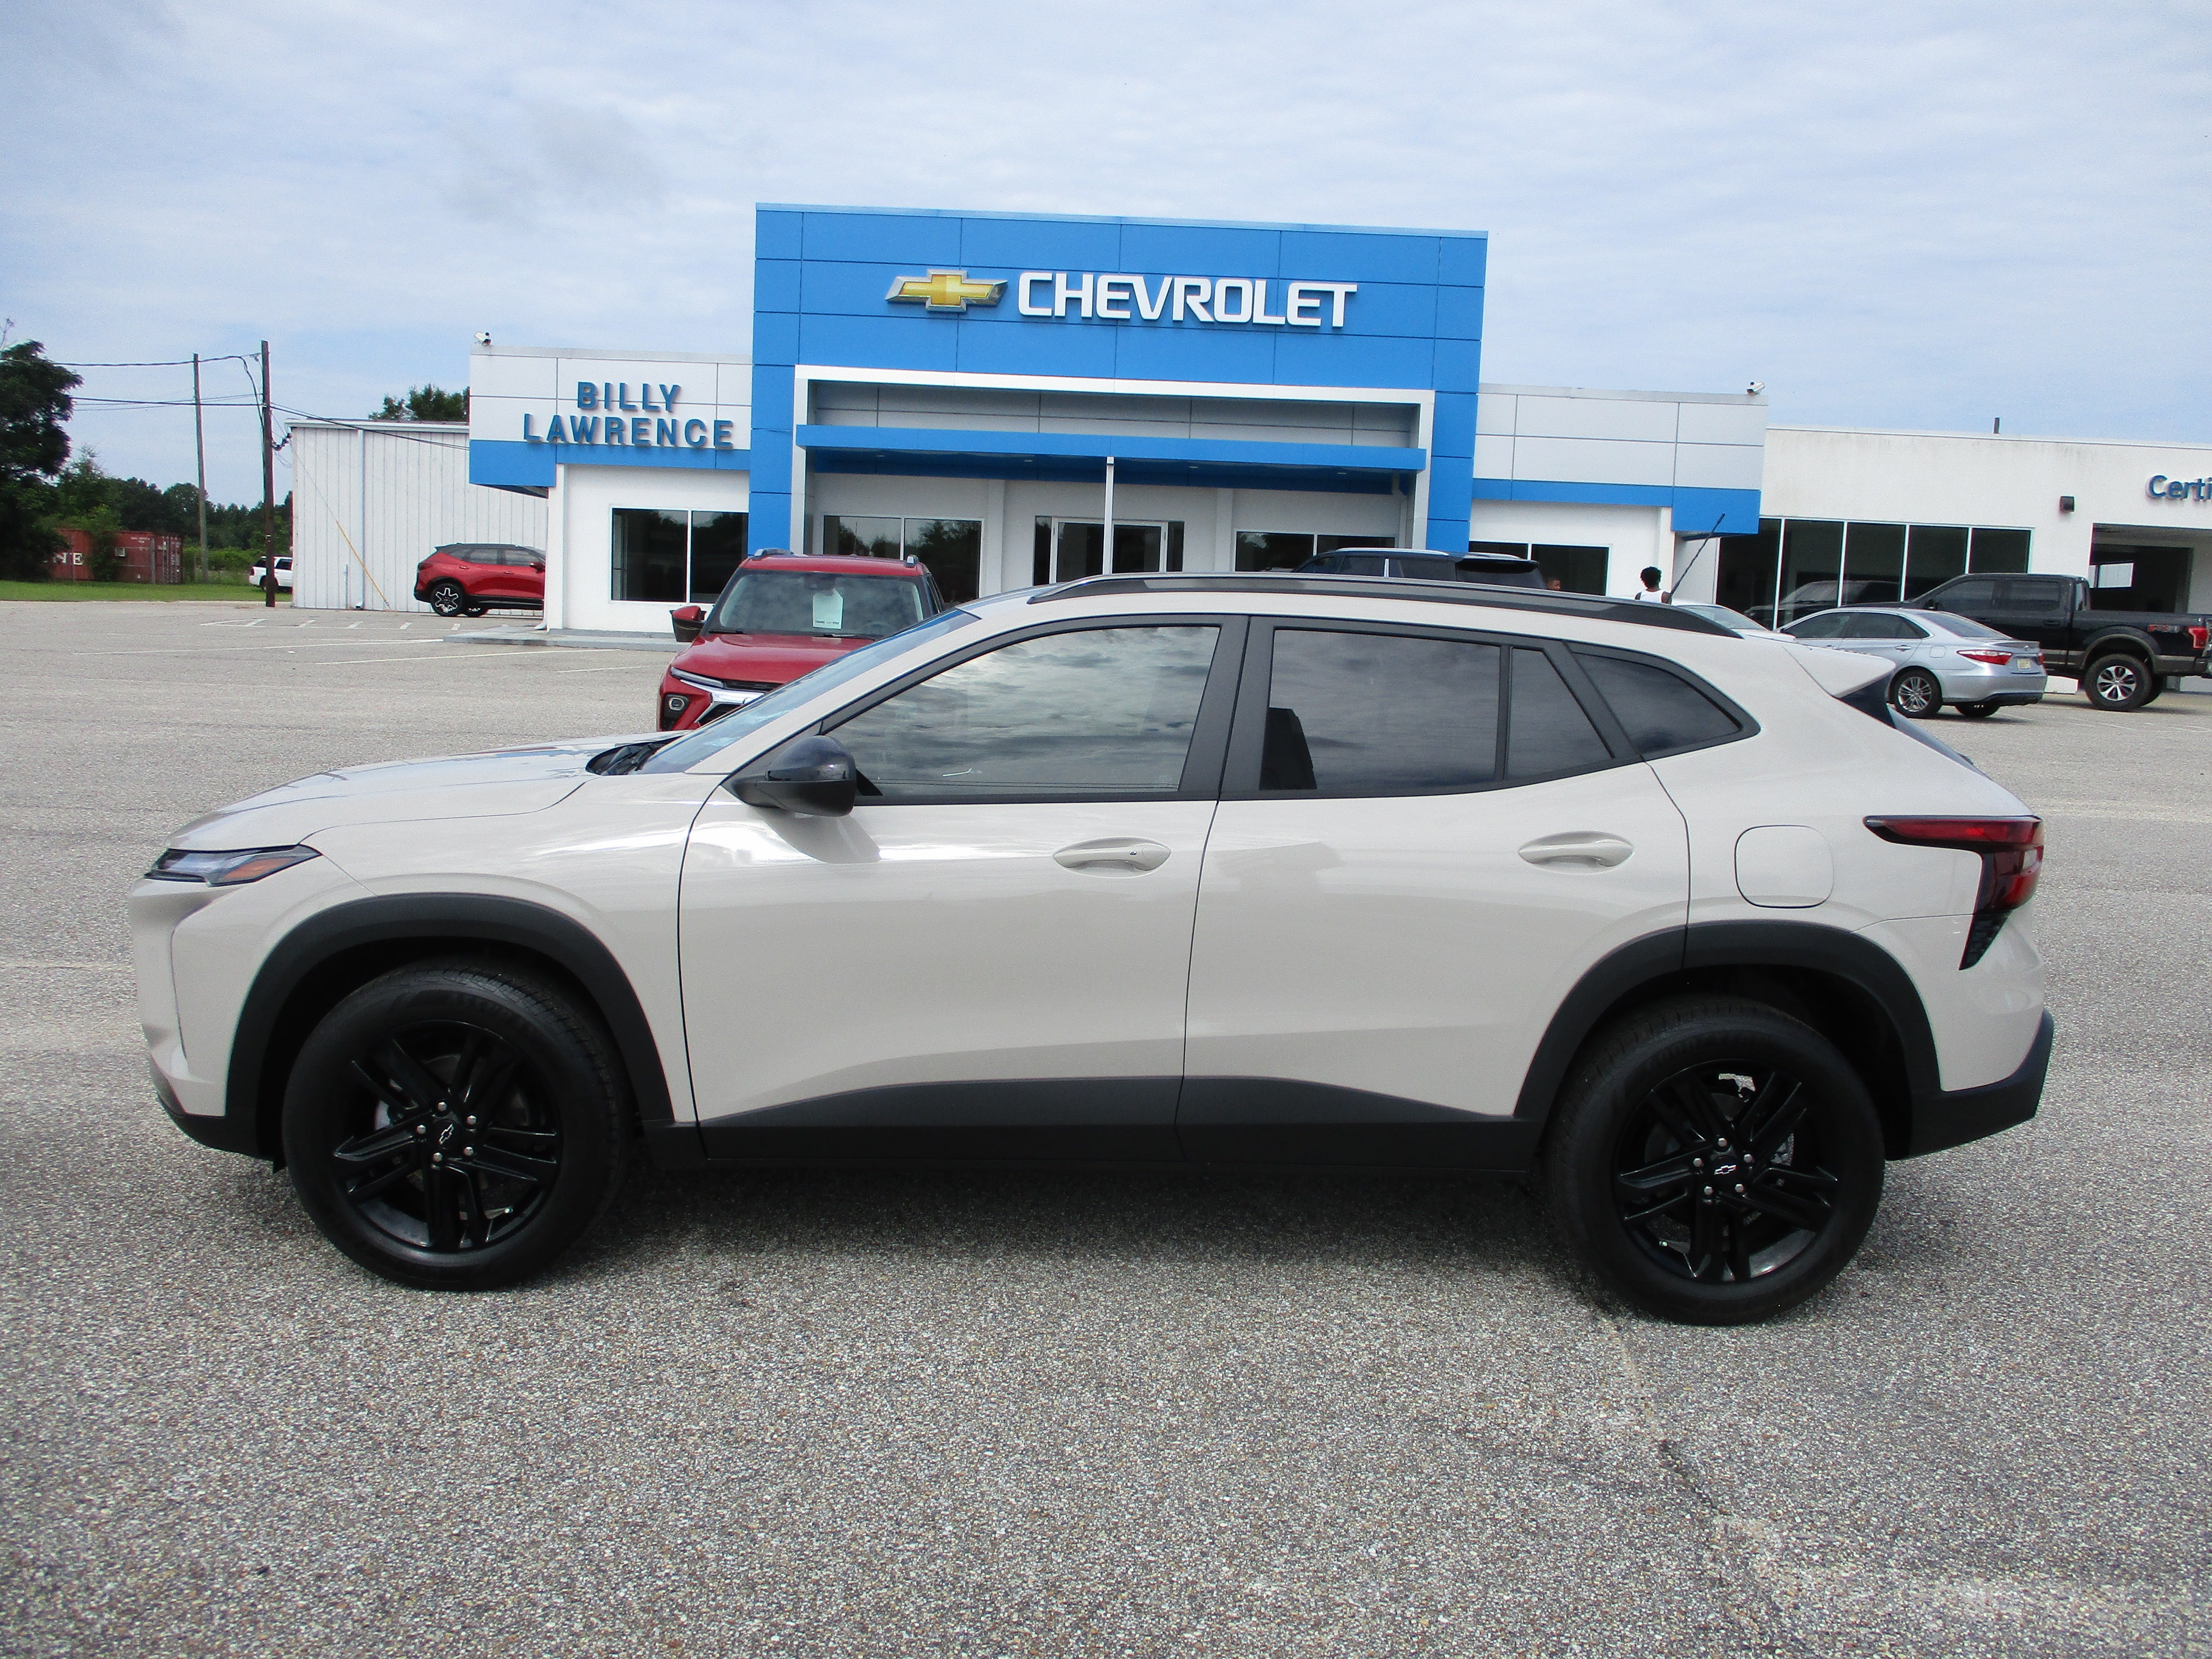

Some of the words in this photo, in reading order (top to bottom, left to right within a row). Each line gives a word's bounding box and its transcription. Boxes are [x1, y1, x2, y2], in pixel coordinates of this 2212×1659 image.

[1018, 272, 1357, 328] CHEVROLET
[577, 382, 681, 412] BILLY
[523, 413, 733, 448] LAWRENCE
[2148, 475, 2212, 500] Certi
